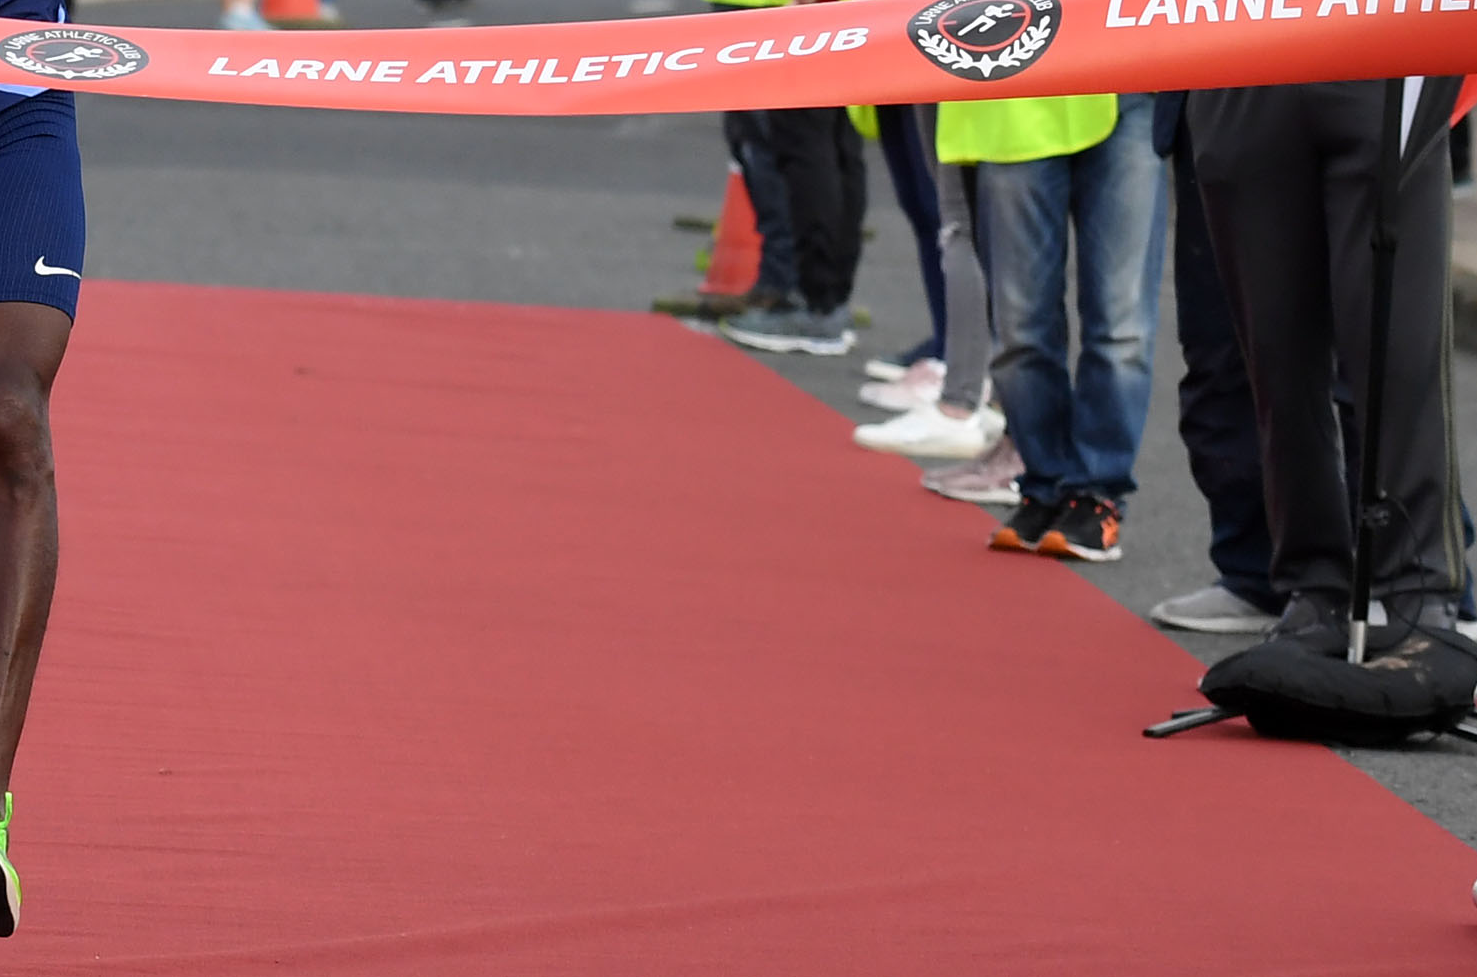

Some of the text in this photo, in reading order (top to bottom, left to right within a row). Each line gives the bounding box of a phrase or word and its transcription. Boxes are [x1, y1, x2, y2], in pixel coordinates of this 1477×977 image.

[915, 0, 954, 25] LARNE
[4, 30, 141, 59] LARNE ATHLETIC CLUB
[208, 27, 870, 85] LARNE ATHLETIC CLUB
